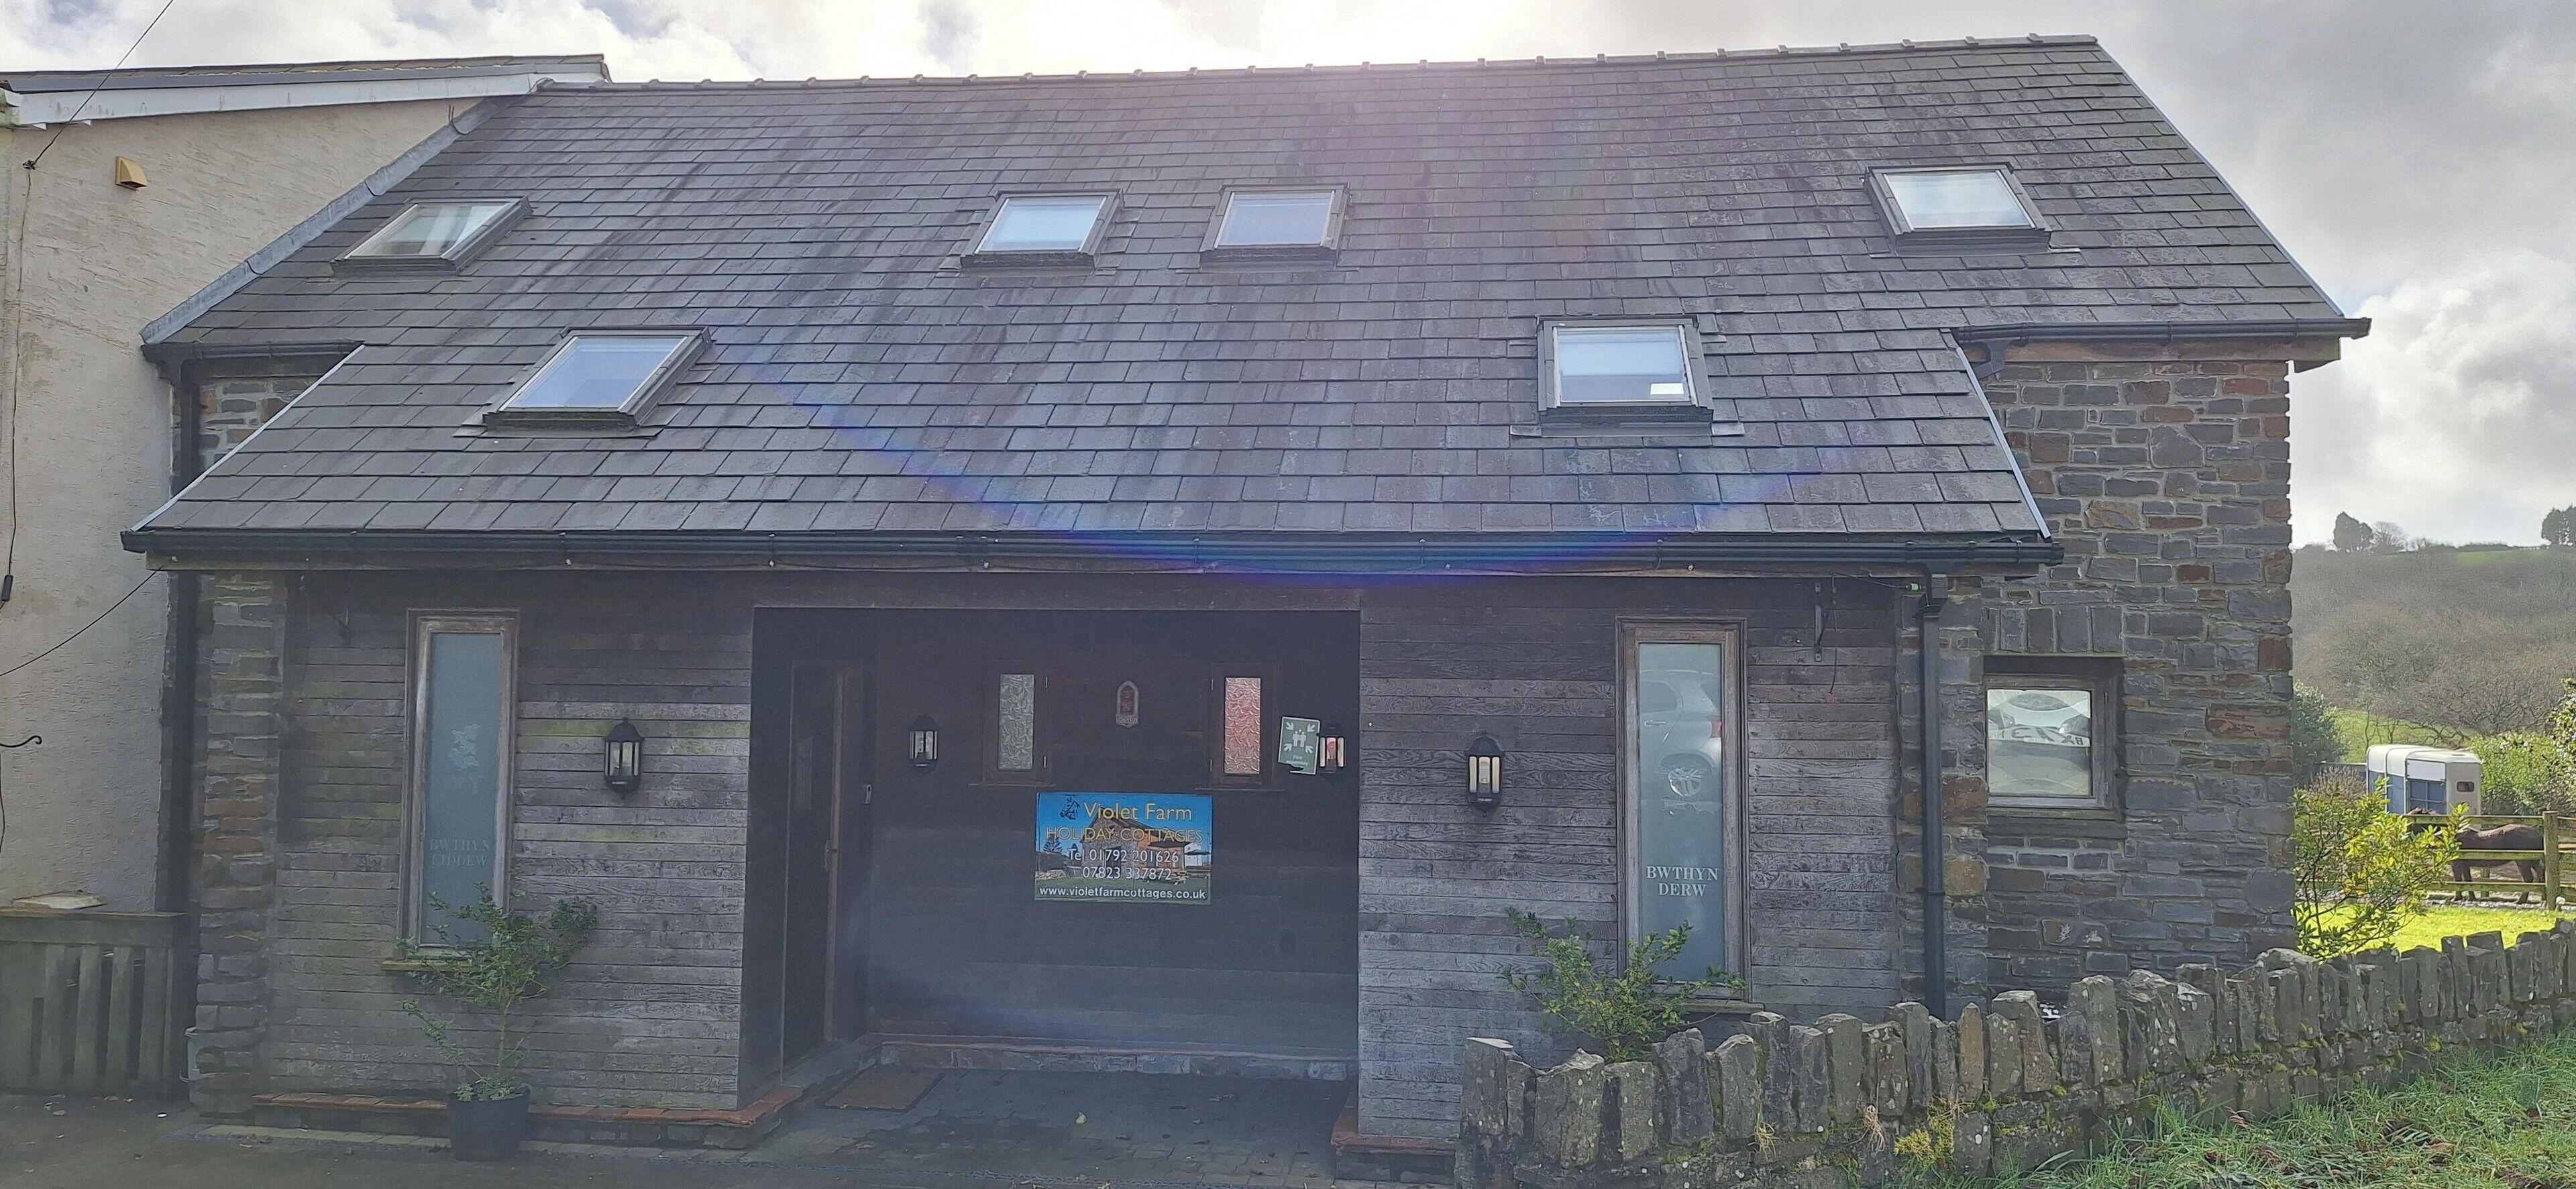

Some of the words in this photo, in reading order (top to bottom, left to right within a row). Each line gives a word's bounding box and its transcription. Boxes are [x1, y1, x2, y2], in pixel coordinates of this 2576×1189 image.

[1084, 802, 1138, 820] Violet
[1146, 803, 1192, 821] Farm
[1046, 827, 1114, 841] HOLIDAY
[1120, 828, 1203, 843] COTTAGES
[429, 839, 492, 851] BWTHYN
[1069, 849, 1085, 861] Tel
[1089, 850, 1128, 862] 01792
[1132, 850, 1179, 863] 201626
[1083, 867, 1121, 879] 07823
[1126, 868, 1173, 881] 337872
[1646, 866, 1719, 881] BWTHYN
[1040, 887, 1207, 900] www.violetfarmcottages.co.uk
[1658, 883, 1707, 897] DERW
